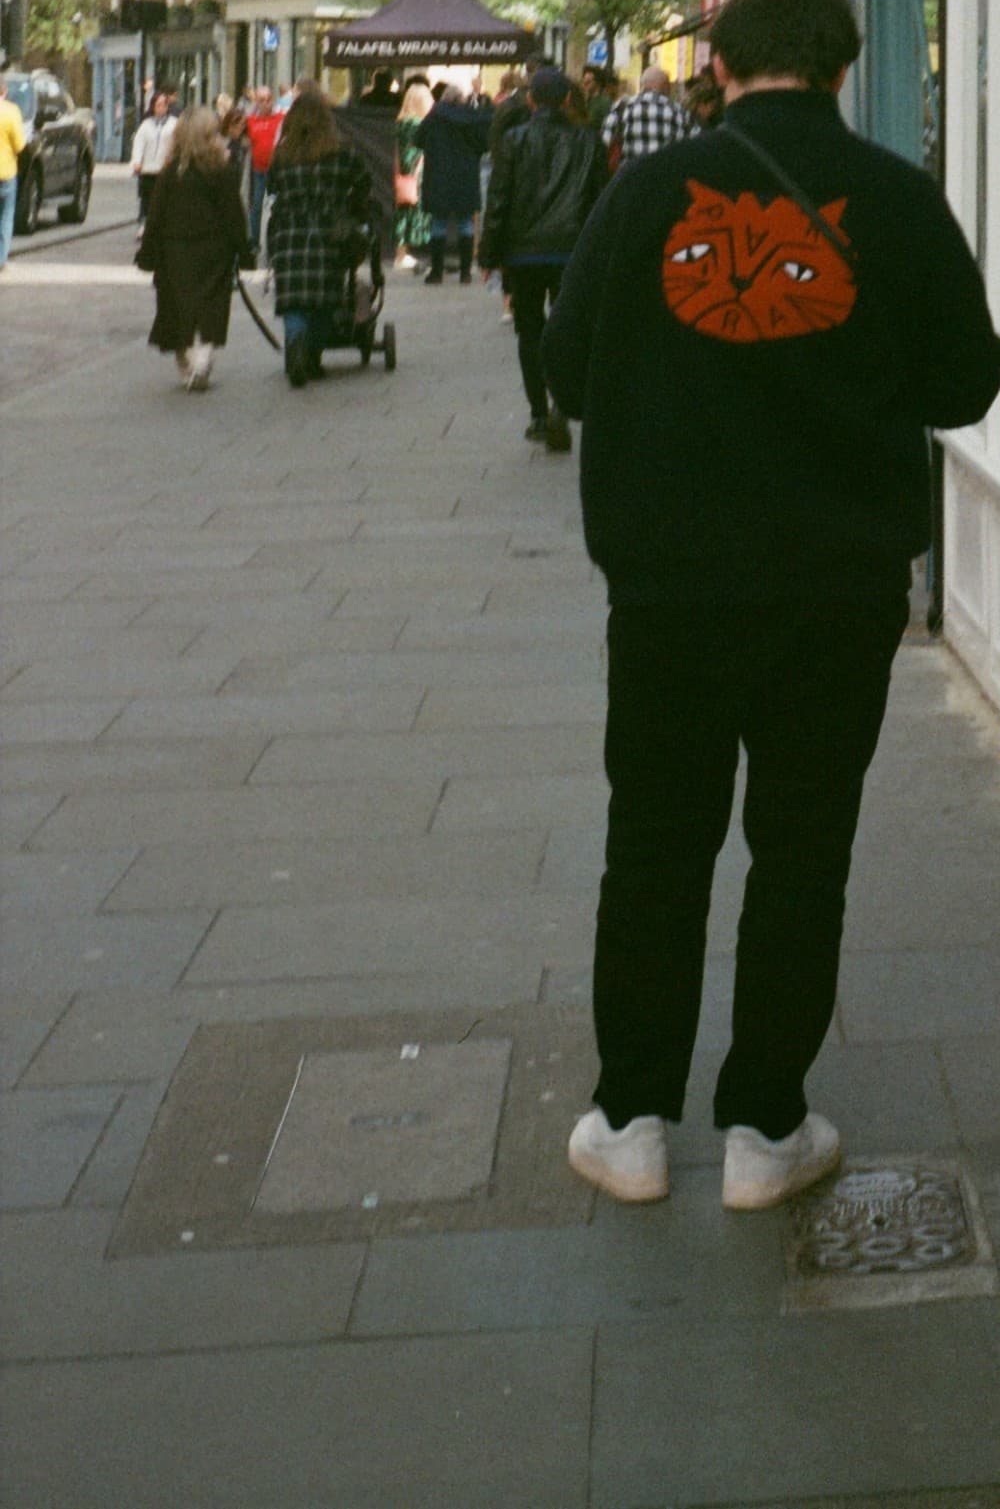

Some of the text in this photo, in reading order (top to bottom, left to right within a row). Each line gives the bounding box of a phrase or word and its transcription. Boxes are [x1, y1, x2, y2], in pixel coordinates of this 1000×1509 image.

[336, 39, 518, 57] FALAFEL WRAPS & SALADS
